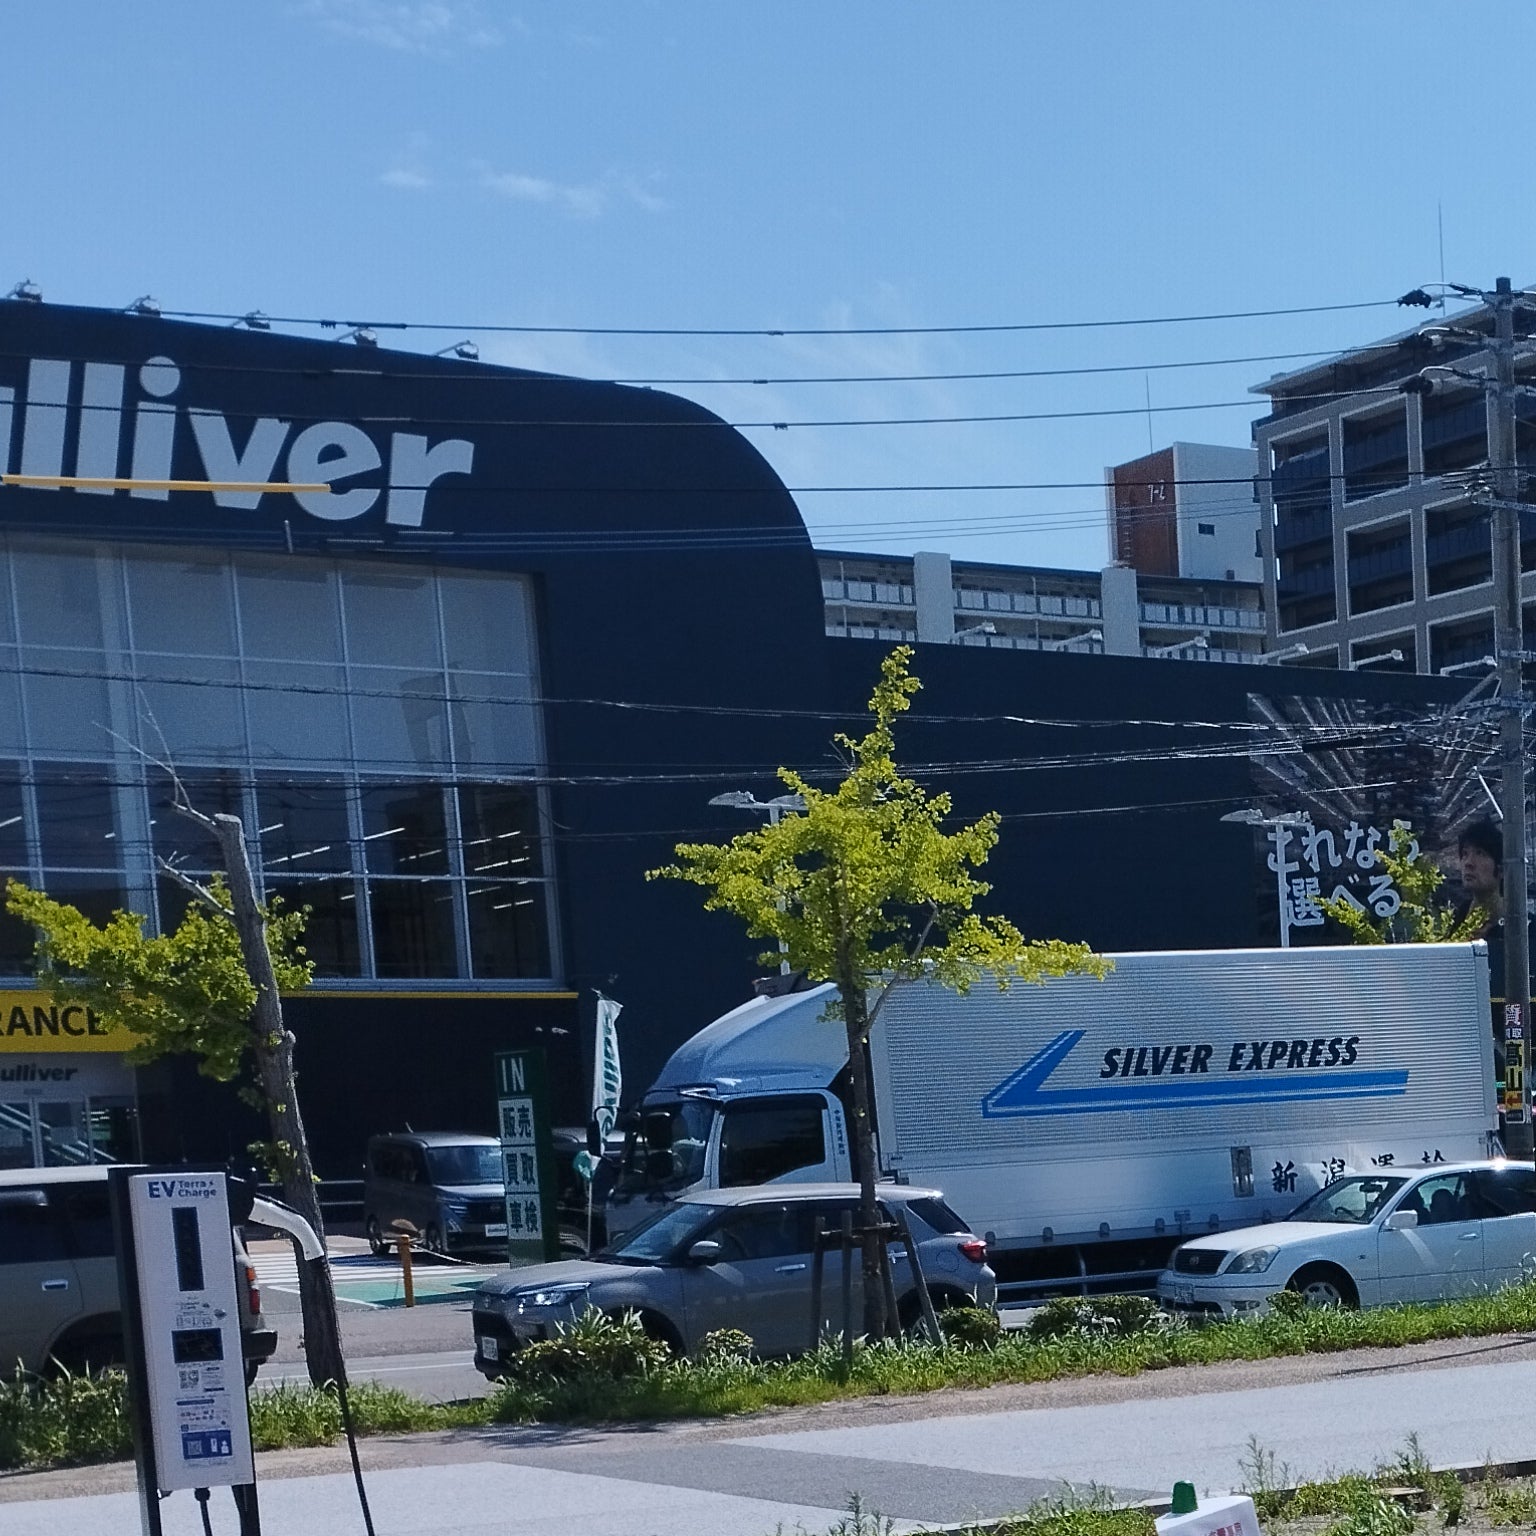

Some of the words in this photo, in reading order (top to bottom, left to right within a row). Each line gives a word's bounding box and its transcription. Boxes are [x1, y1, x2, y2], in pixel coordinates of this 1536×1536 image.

[0, 1005, 108, 1036] ANCE
[1099, 1044, 1213, 1079] SILVER
[1227, 1036, 1360, 1072] EXPRESS
[502, 1057, 525, 1092] IN
[503, 1105, 532, 1138] 販売
[178, 1180, 206, 1188] Terra
[506, 1153, 536, 1186] 買取
[148, 1180, 177, 1199] EV
[178, 1188, 217, 1198] Charge
[510, 1200, 539, 1233] 車検
